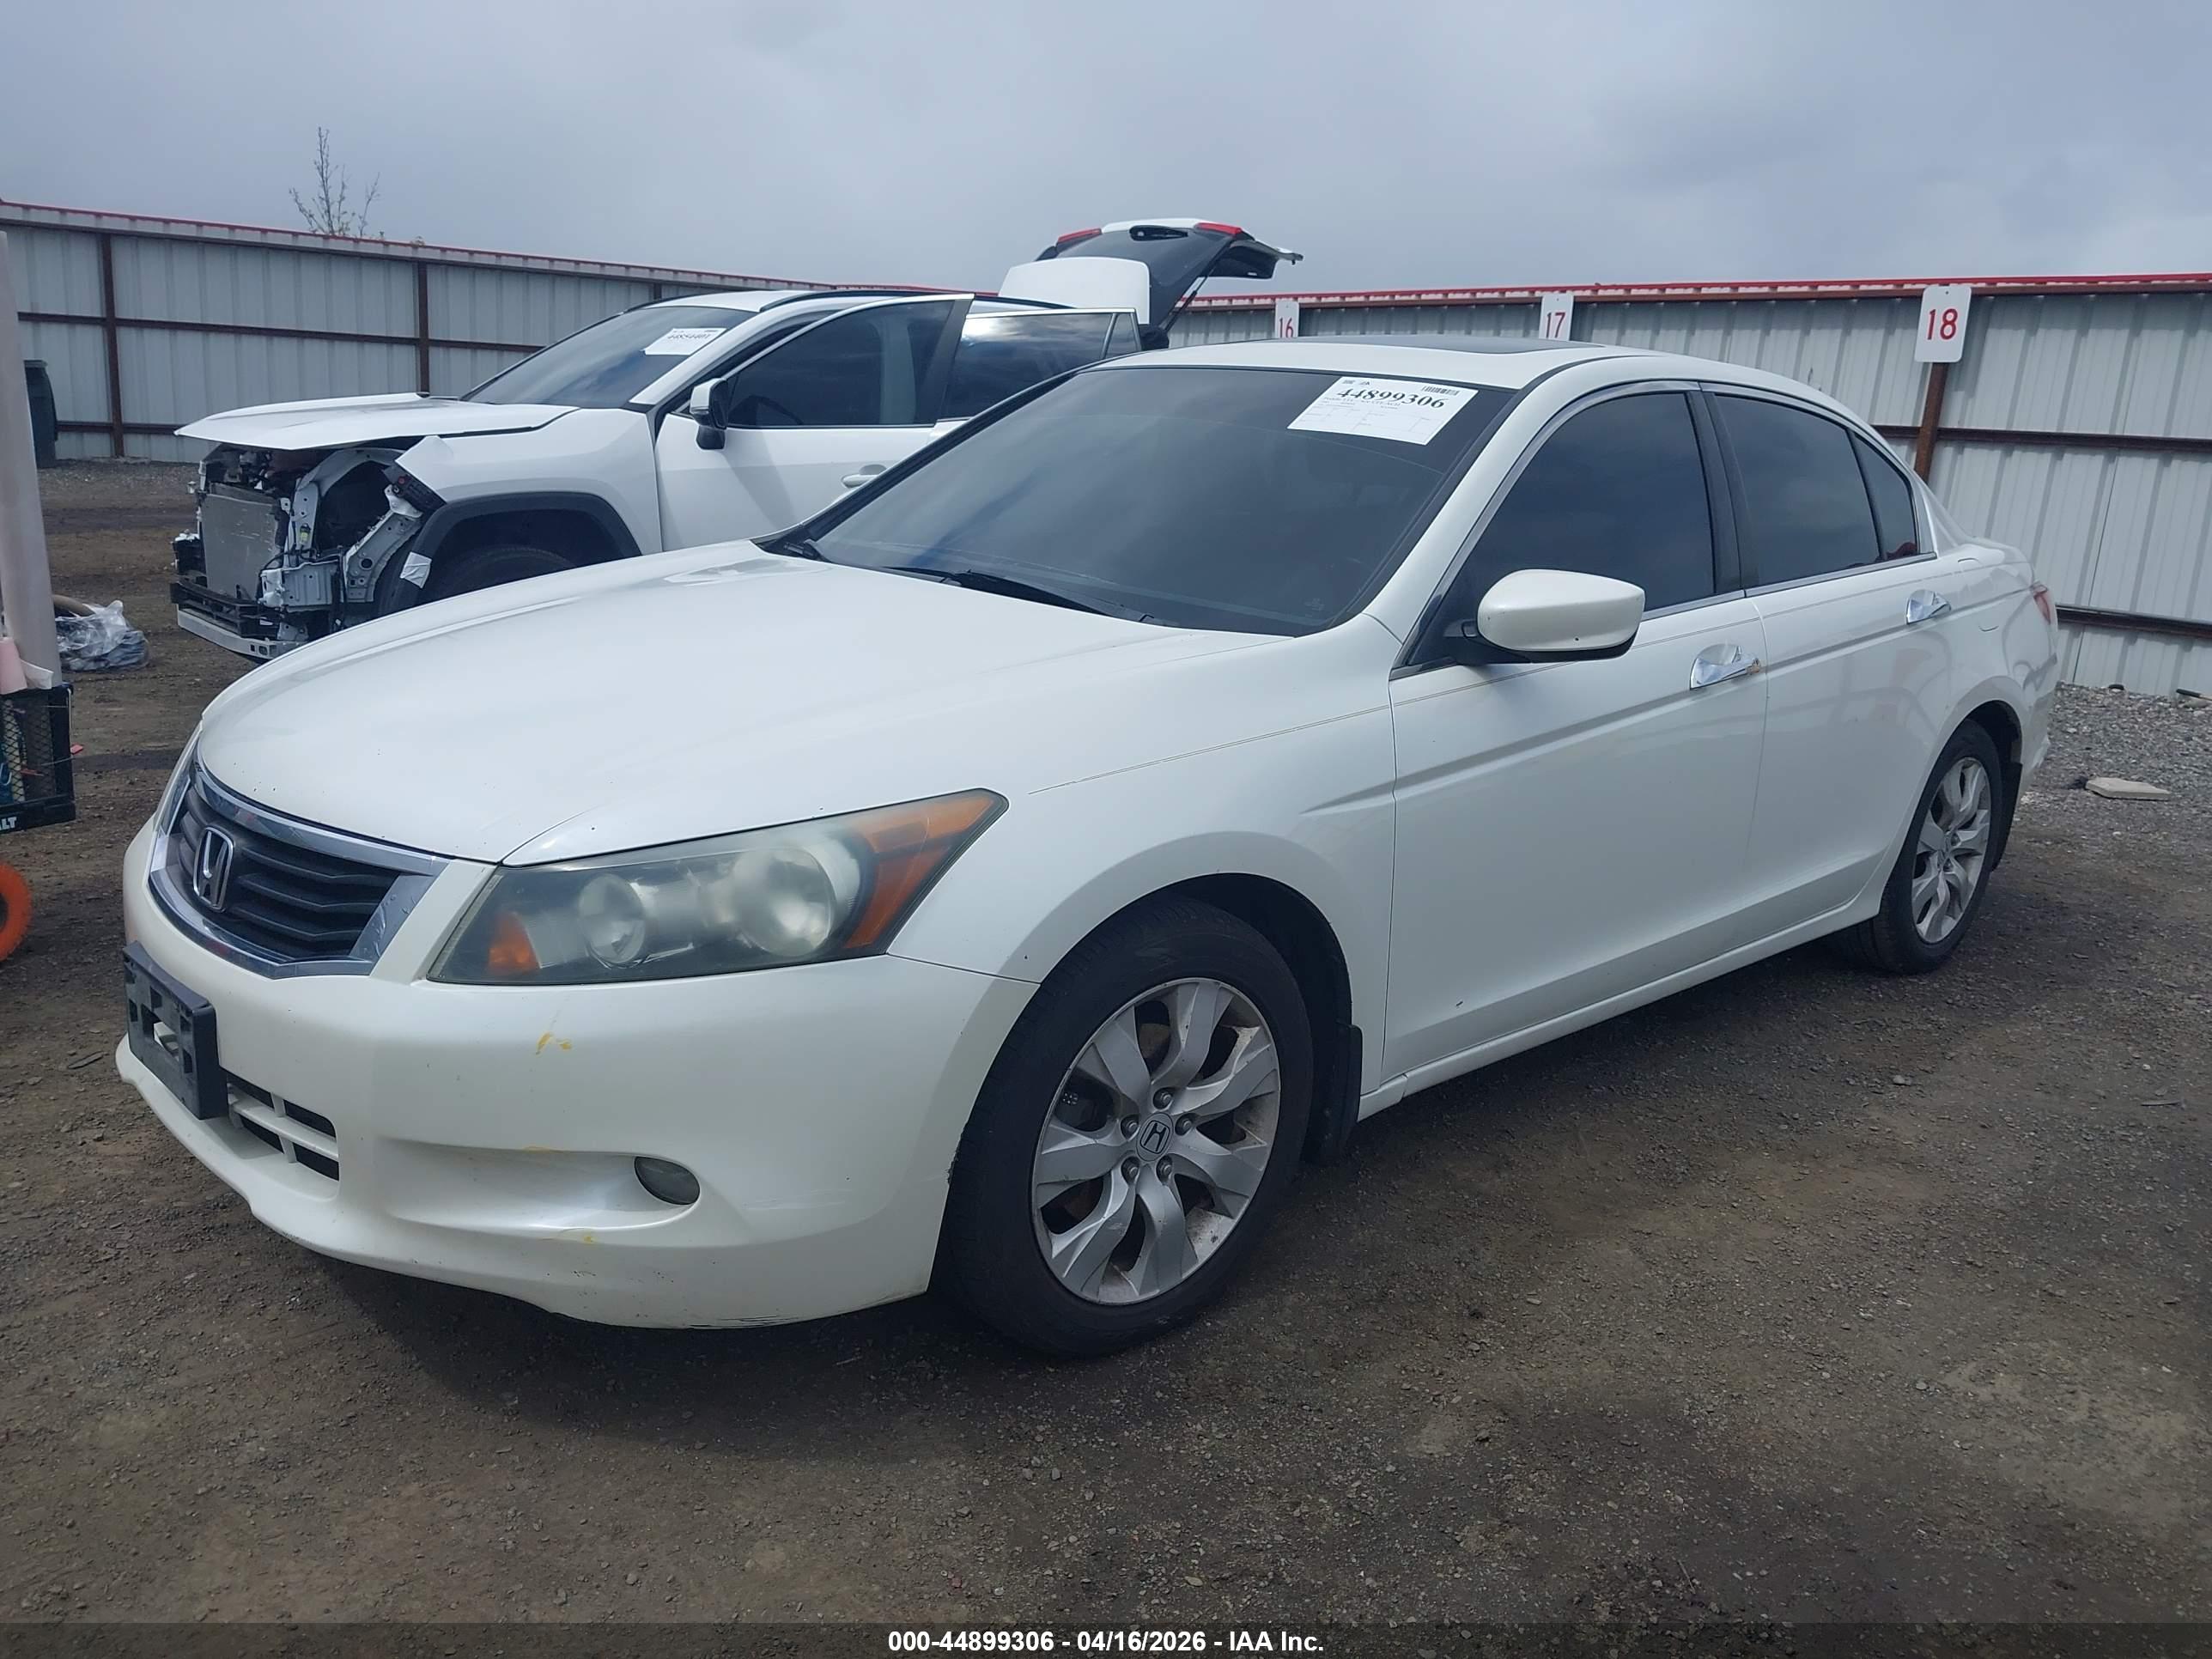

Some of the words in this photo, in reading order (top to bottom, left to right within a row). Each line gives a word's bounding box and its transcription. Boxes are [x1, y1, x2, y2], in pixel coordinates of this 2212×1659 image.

[1279, 317, 1293, 338] 16
[1546, 312, 1566, 338] 17
[1927, 308, 1958, 340] 18
[1336, 388, 1449, 409] 44899306
[0, 816, 17, 831] LT
